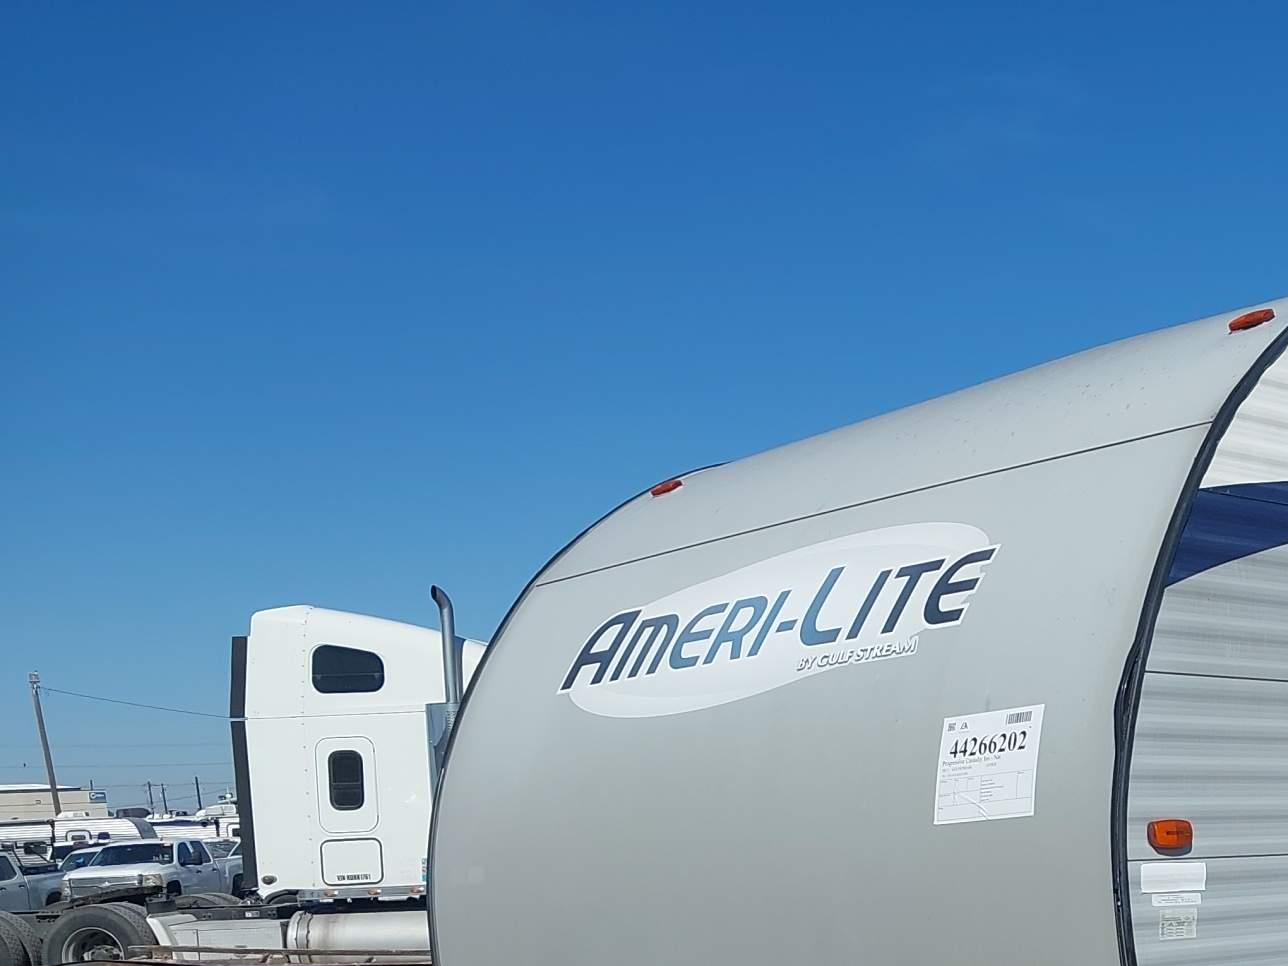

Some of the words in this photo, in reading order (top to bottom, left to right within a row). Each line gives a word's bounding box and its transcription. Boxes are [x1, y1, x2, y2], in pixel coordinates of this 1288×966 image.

[797, 655, 817, 671] BY
[817, 649, 854, 667] GULF
[855, 638, 918, 662] STREAM
[949, 731, 1027, 758] 44266202
